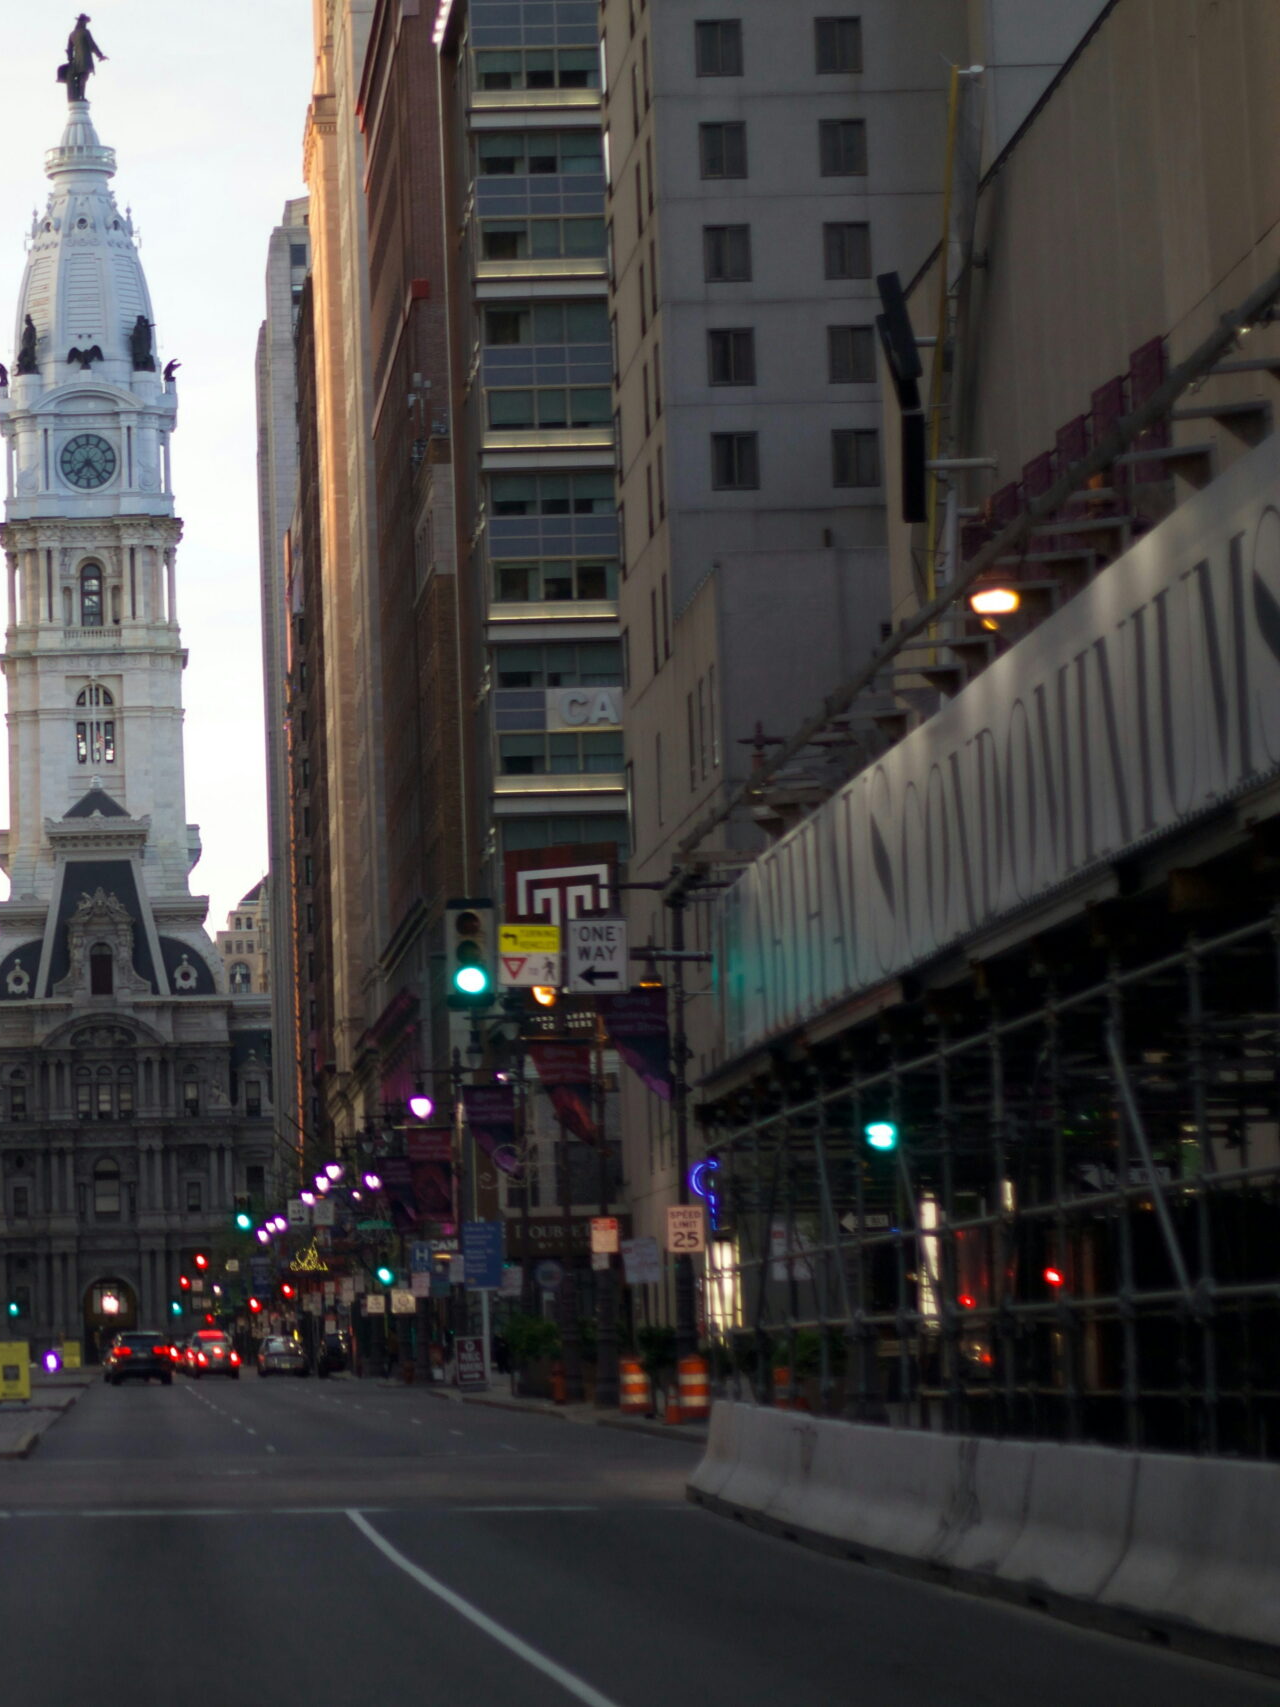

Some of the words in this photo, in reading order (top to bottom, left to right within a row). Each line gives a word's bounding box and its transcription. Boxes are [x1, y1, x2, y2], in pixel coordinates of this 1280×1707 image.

[519, 929, 557, 938] TURNING
[579, 926, 616, 942] ONE
[577, 945, 617, 961] WAY
[670, 1211, 701, 1219] SPEED
[673, 1220, 697, 1228] LIMIT
[673, 1231, 699, 1248] 25
[416, 1248, 428, 1261] H
